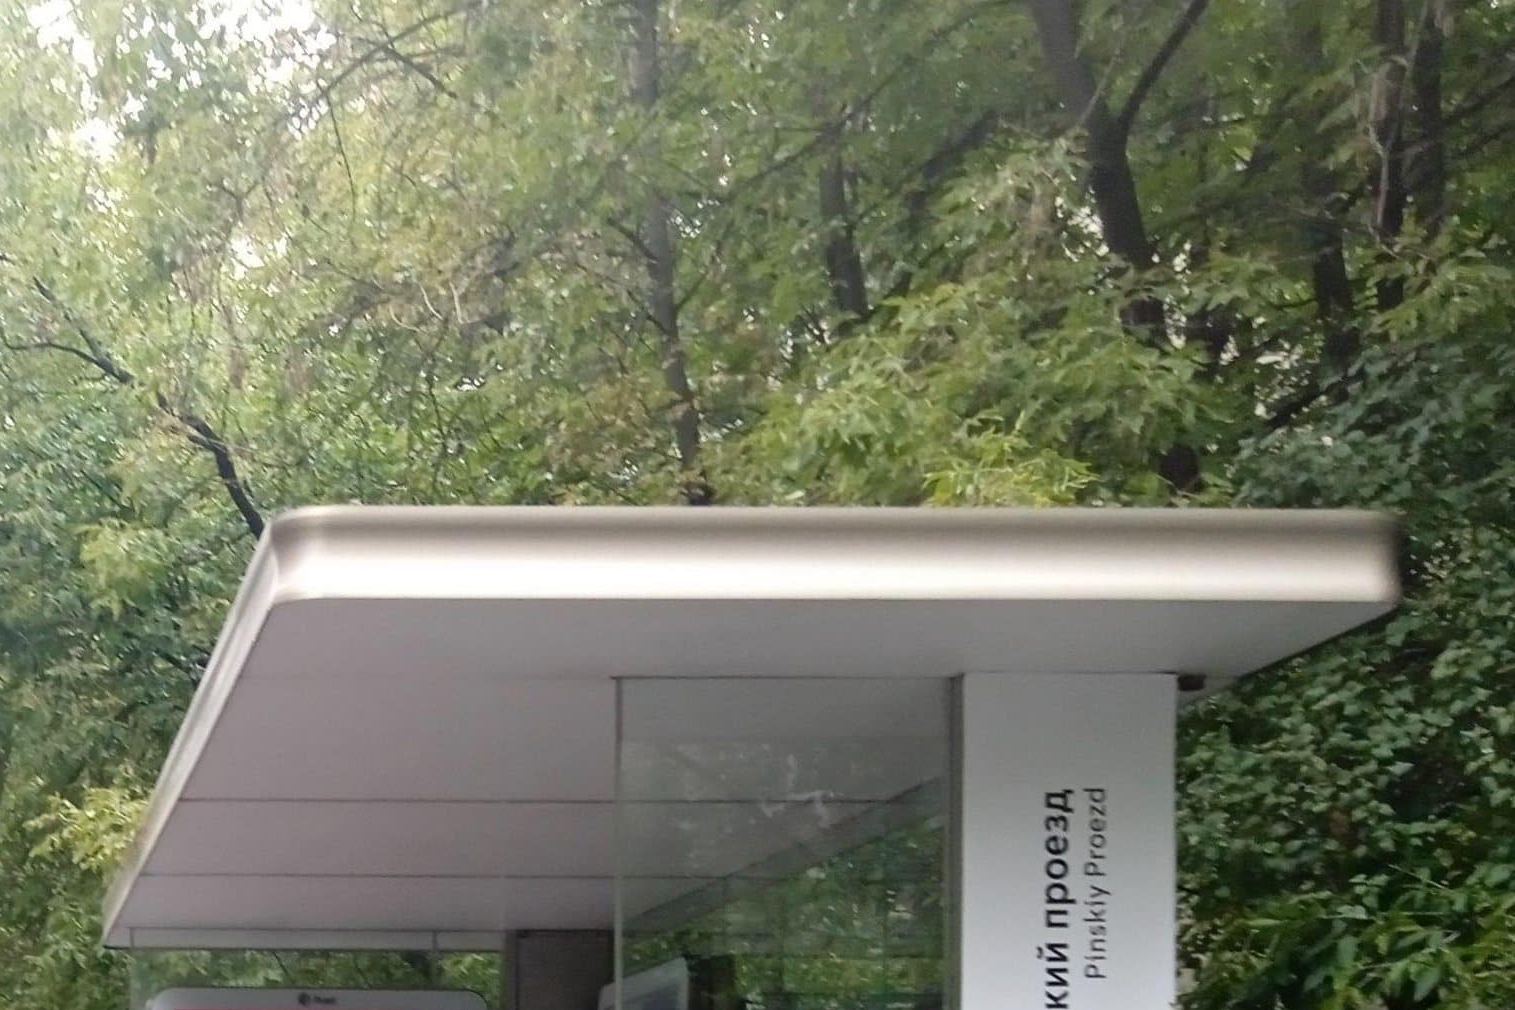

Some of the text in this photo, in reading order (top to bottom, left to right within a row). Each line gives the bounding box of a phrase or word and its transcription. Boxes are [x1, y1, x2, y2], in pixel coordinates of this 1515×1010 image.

[1044, 788, 1076, 929] проезд
[1083, 787, 1111, 979] Pinskiy Proezd
